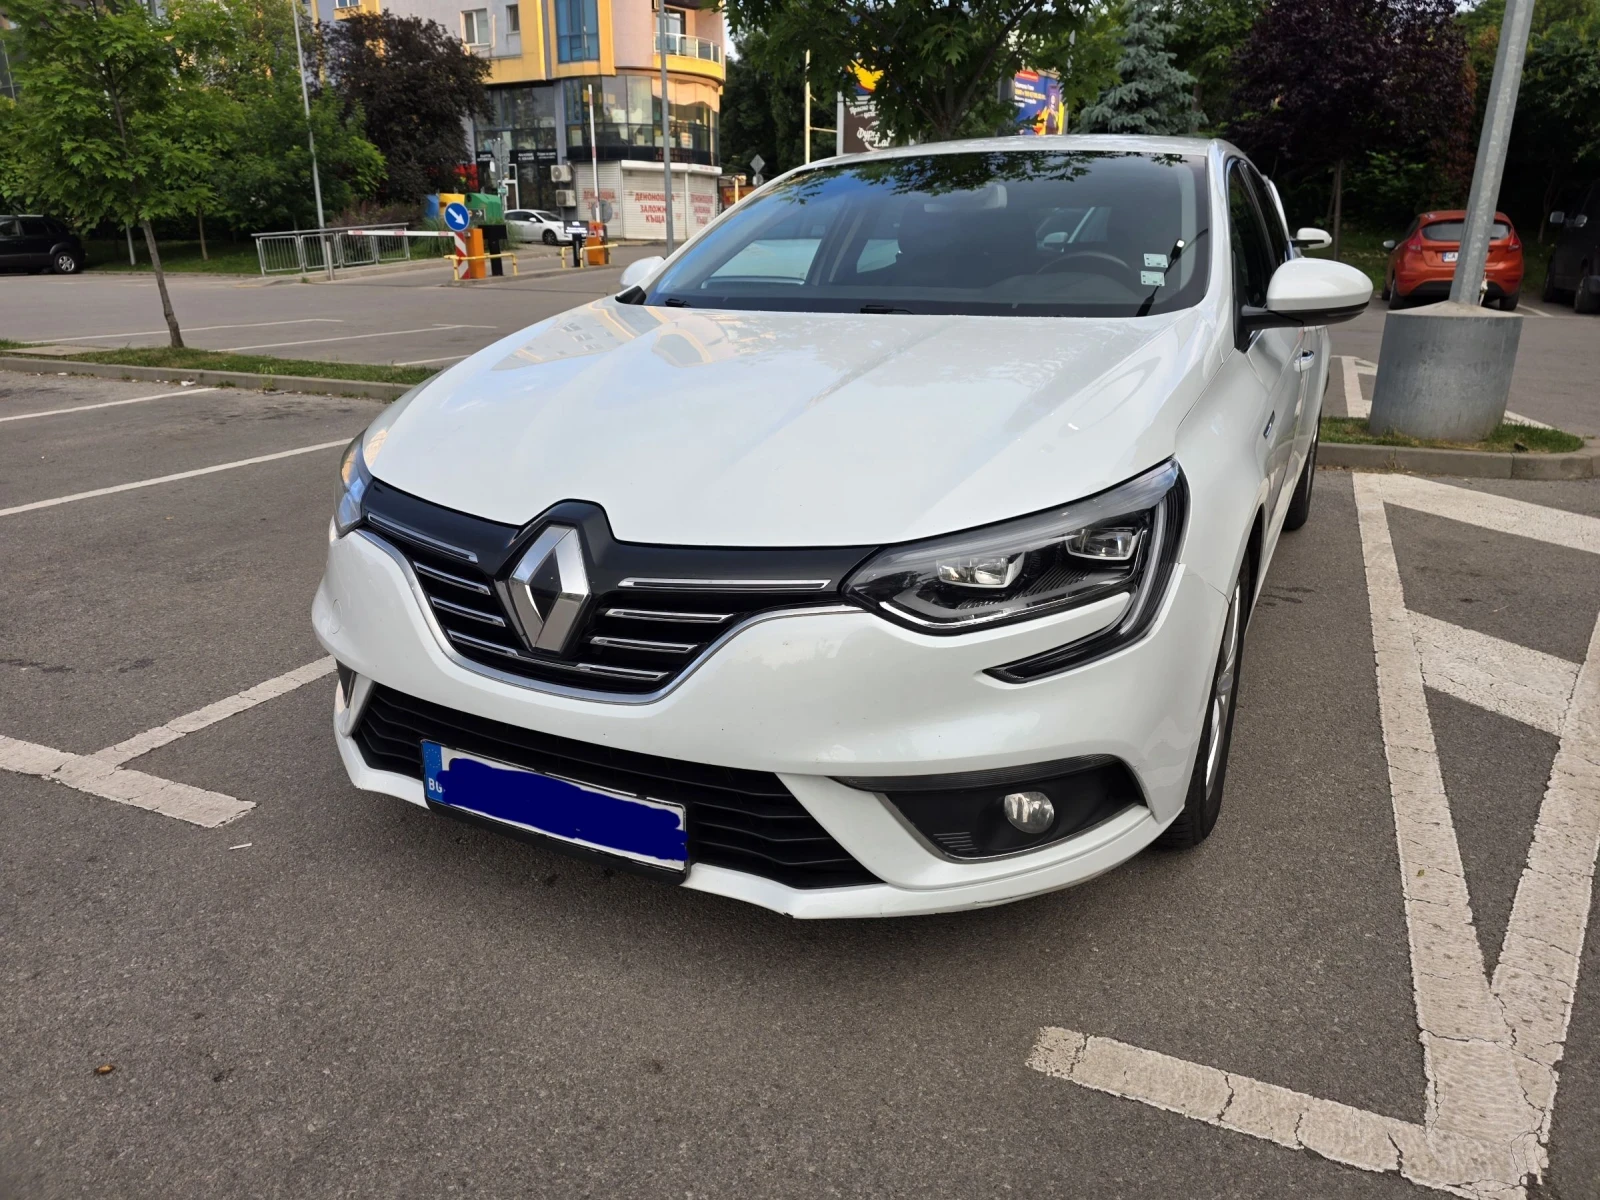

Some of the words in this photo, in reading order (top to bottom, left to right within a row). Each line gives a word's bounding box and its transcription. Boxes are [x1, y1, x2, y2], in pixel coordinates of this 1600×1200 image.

[635, 193, 675, 201] ДЕНОНОЩА
[640, 204, 669, 213] ЗАЛОЖН
[645, 215, 665, 223] КЪЩА
